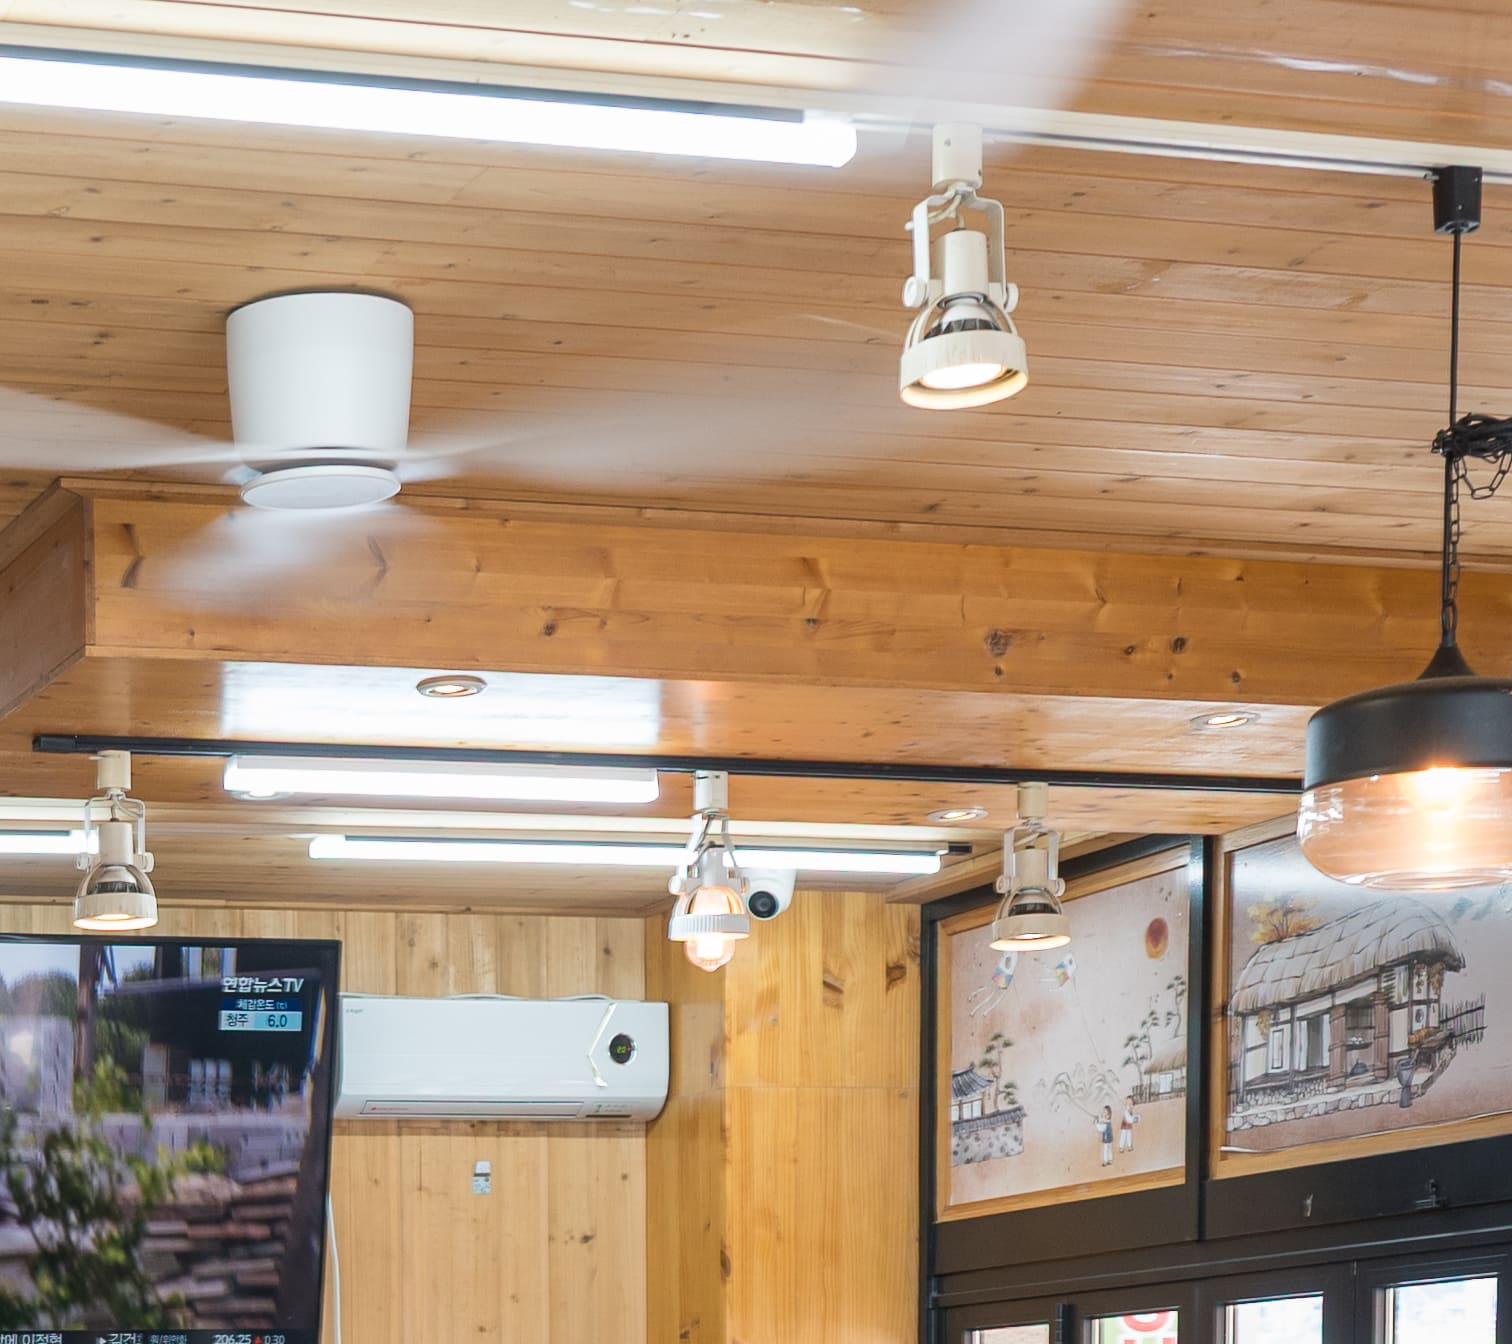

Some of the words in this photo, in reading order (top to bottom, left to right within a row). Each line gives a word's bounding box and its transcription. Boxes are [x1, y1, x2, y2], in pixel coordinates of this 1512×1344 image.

[223, 977, 304, 993] 연합뉴스TV
[236, 999, 275, 1010] 체감온도
[227, 1013, 248, 1027] 청주
[268, 1014, 287, 1028] 6.0
